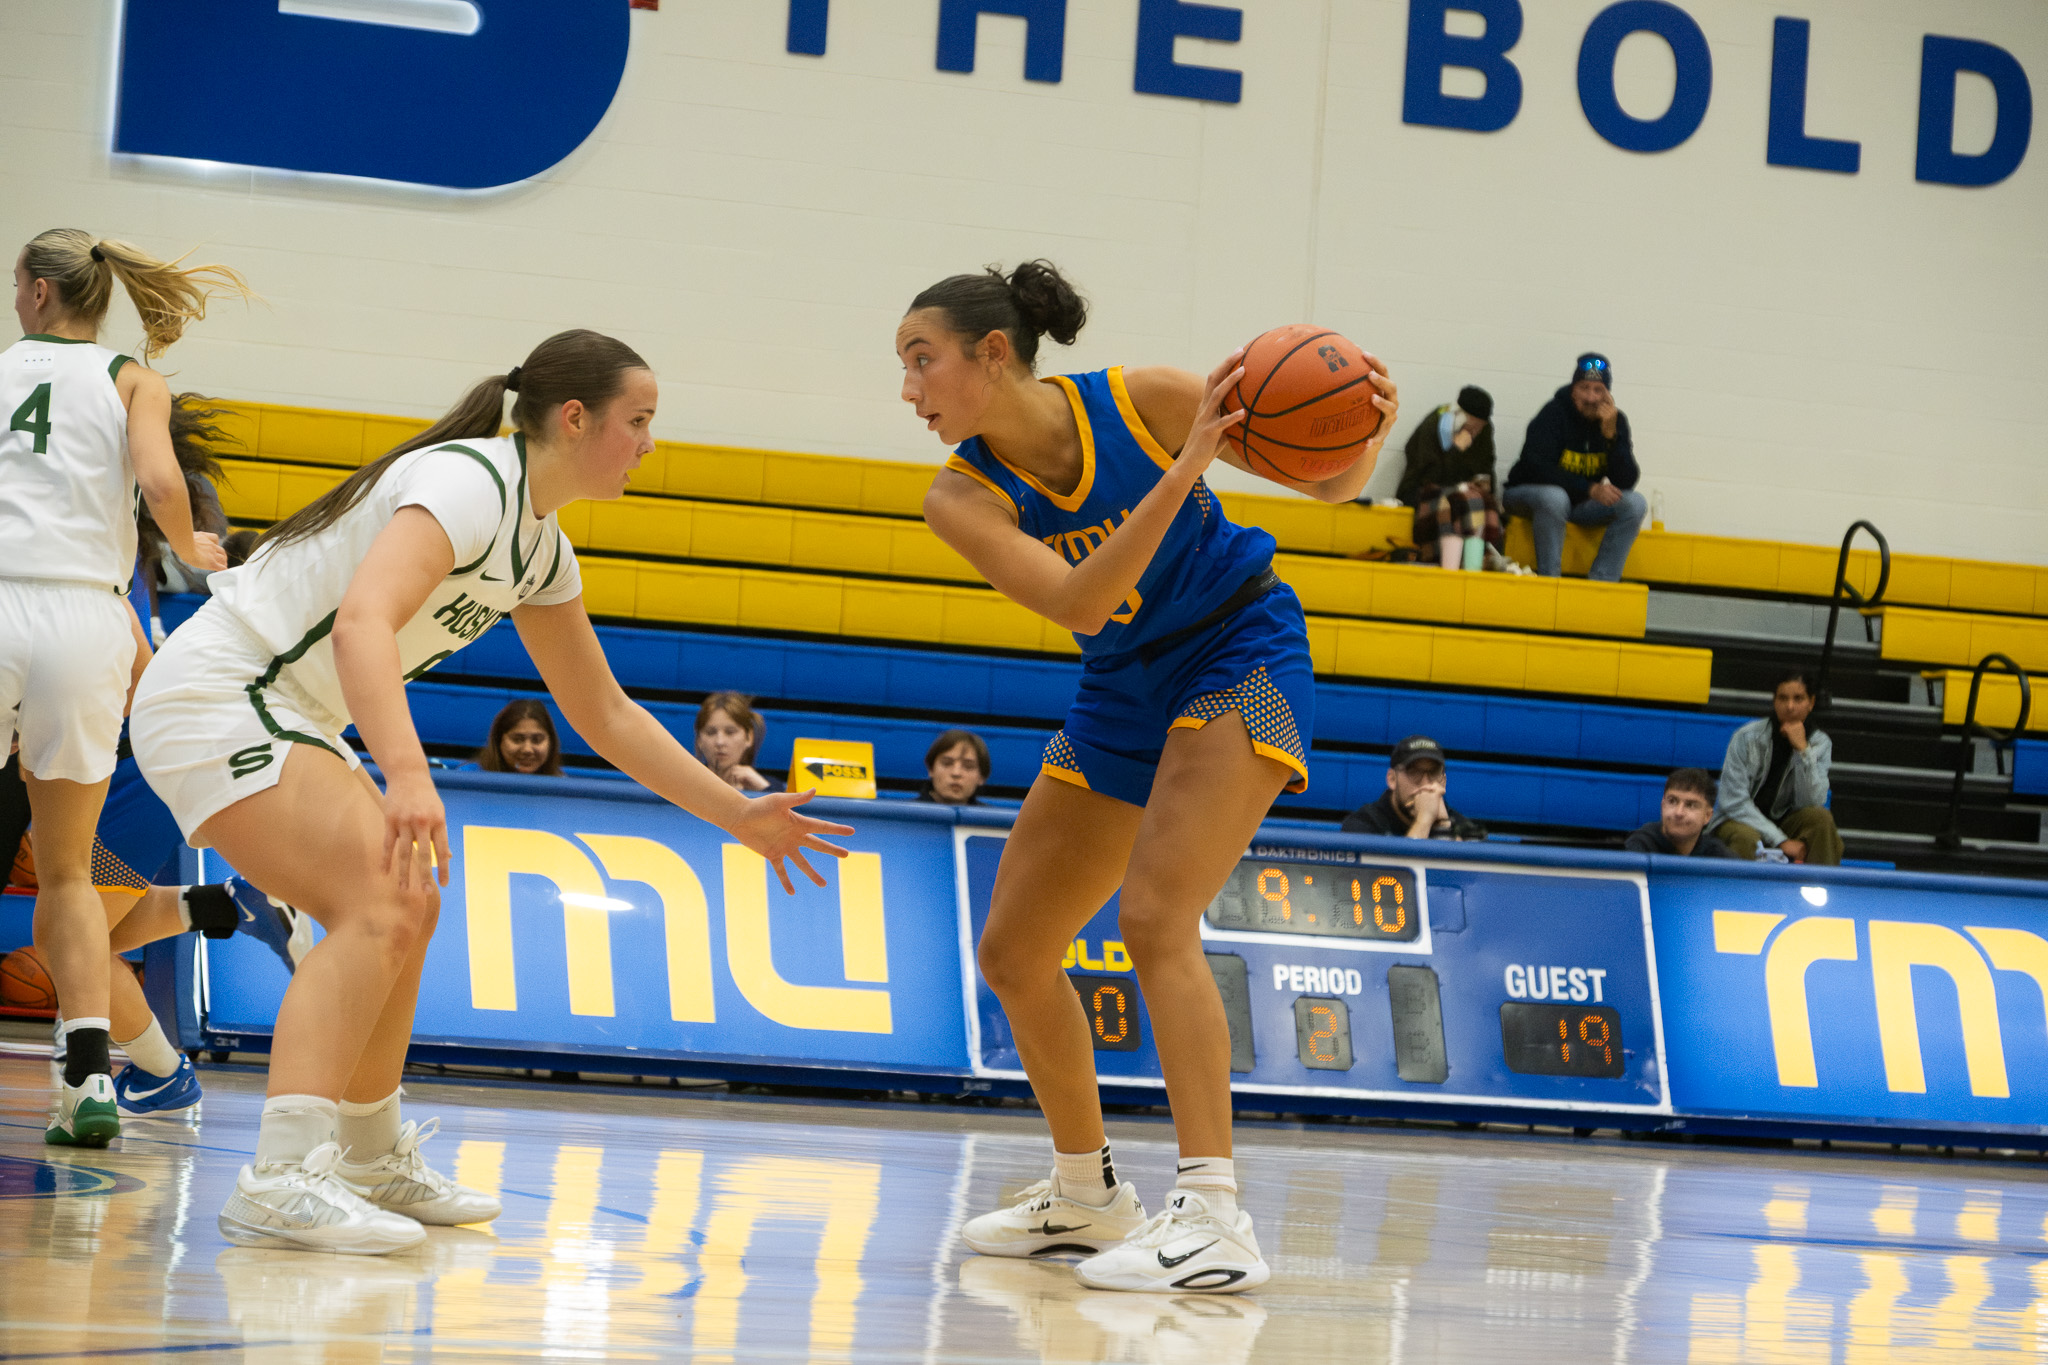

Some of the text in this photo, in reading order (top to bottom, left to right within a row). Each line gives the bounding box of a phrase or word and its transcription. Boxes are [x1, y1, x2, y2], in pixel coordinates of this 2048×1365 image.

[1401, 0, 2034, 189] BOLD
[10, 382, 51, 454] 4
[228, 742, 274, 780] S
[1256, 848, 1356, 864] DAKTRONICS
[1257, 867, 1406, 933] 9:10
[411, 825, 893, 1035] MU
[1273, 964, 1362, 995] PERIOD
[1505, 964, 1607, 1003] GUEST
[1308, 1006, 1337, 1062] 2
[1559, 1015, 1611, 1064] 19
